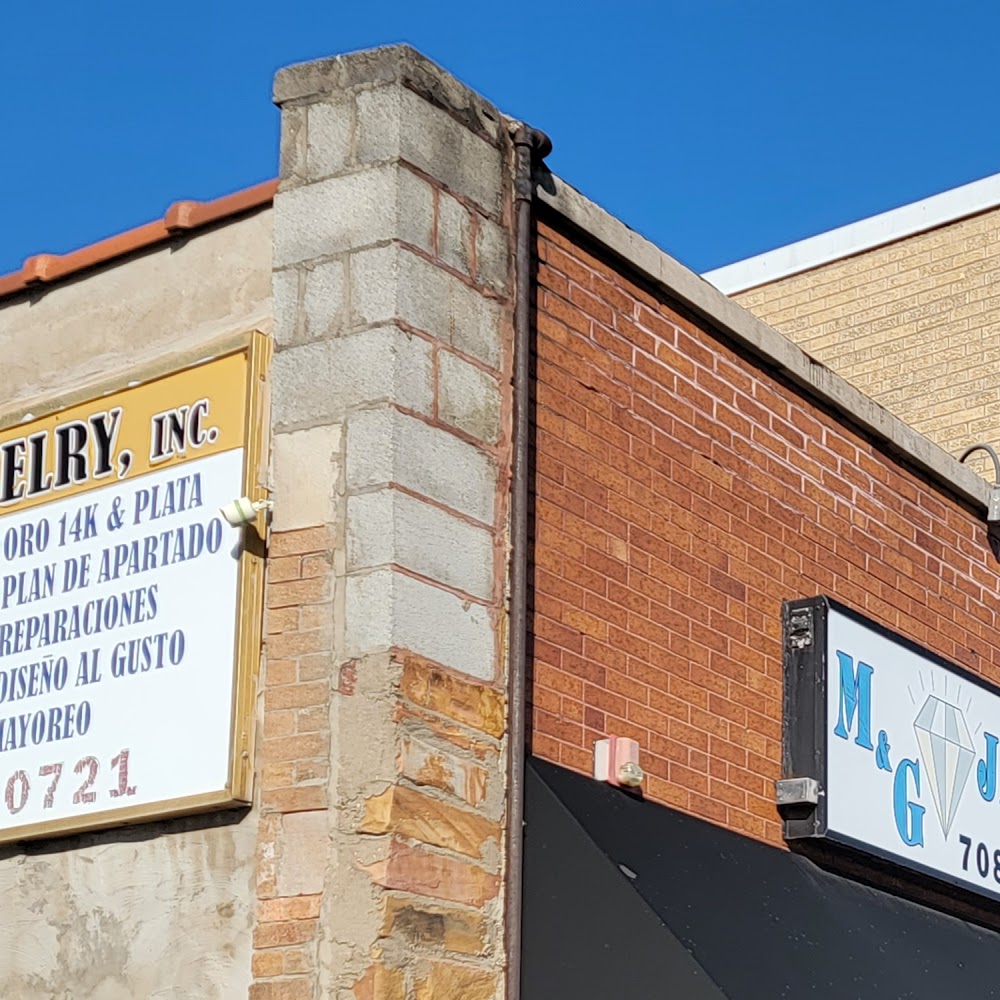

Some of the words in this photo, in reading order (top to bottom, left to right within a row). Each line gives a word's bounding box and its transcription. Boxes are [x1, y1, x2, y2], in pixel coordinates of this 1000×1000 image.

[150, 399, 219, 462] INC.
[4, 517, 50, 562] ORO
[57, 502, 98, 548] 14K
[106, 495, 126, 533] &
[133, 472, 204, 526] PLATA
[1, 562, 57, 609] PLAN
[62, 551, 92, 594] DE
[97, 517, 224, 584] APARTADO
[0, 583, 159, 657] REPARACIONES
[75, 648, 102, 688] AL
[111, 629, 186, 679] GUSTO
[4, 747, 138, 815] 0721
[834, 649, 874, 751] M
[875, 729, 892, 772] &
[893, 758, 926, 848] G
